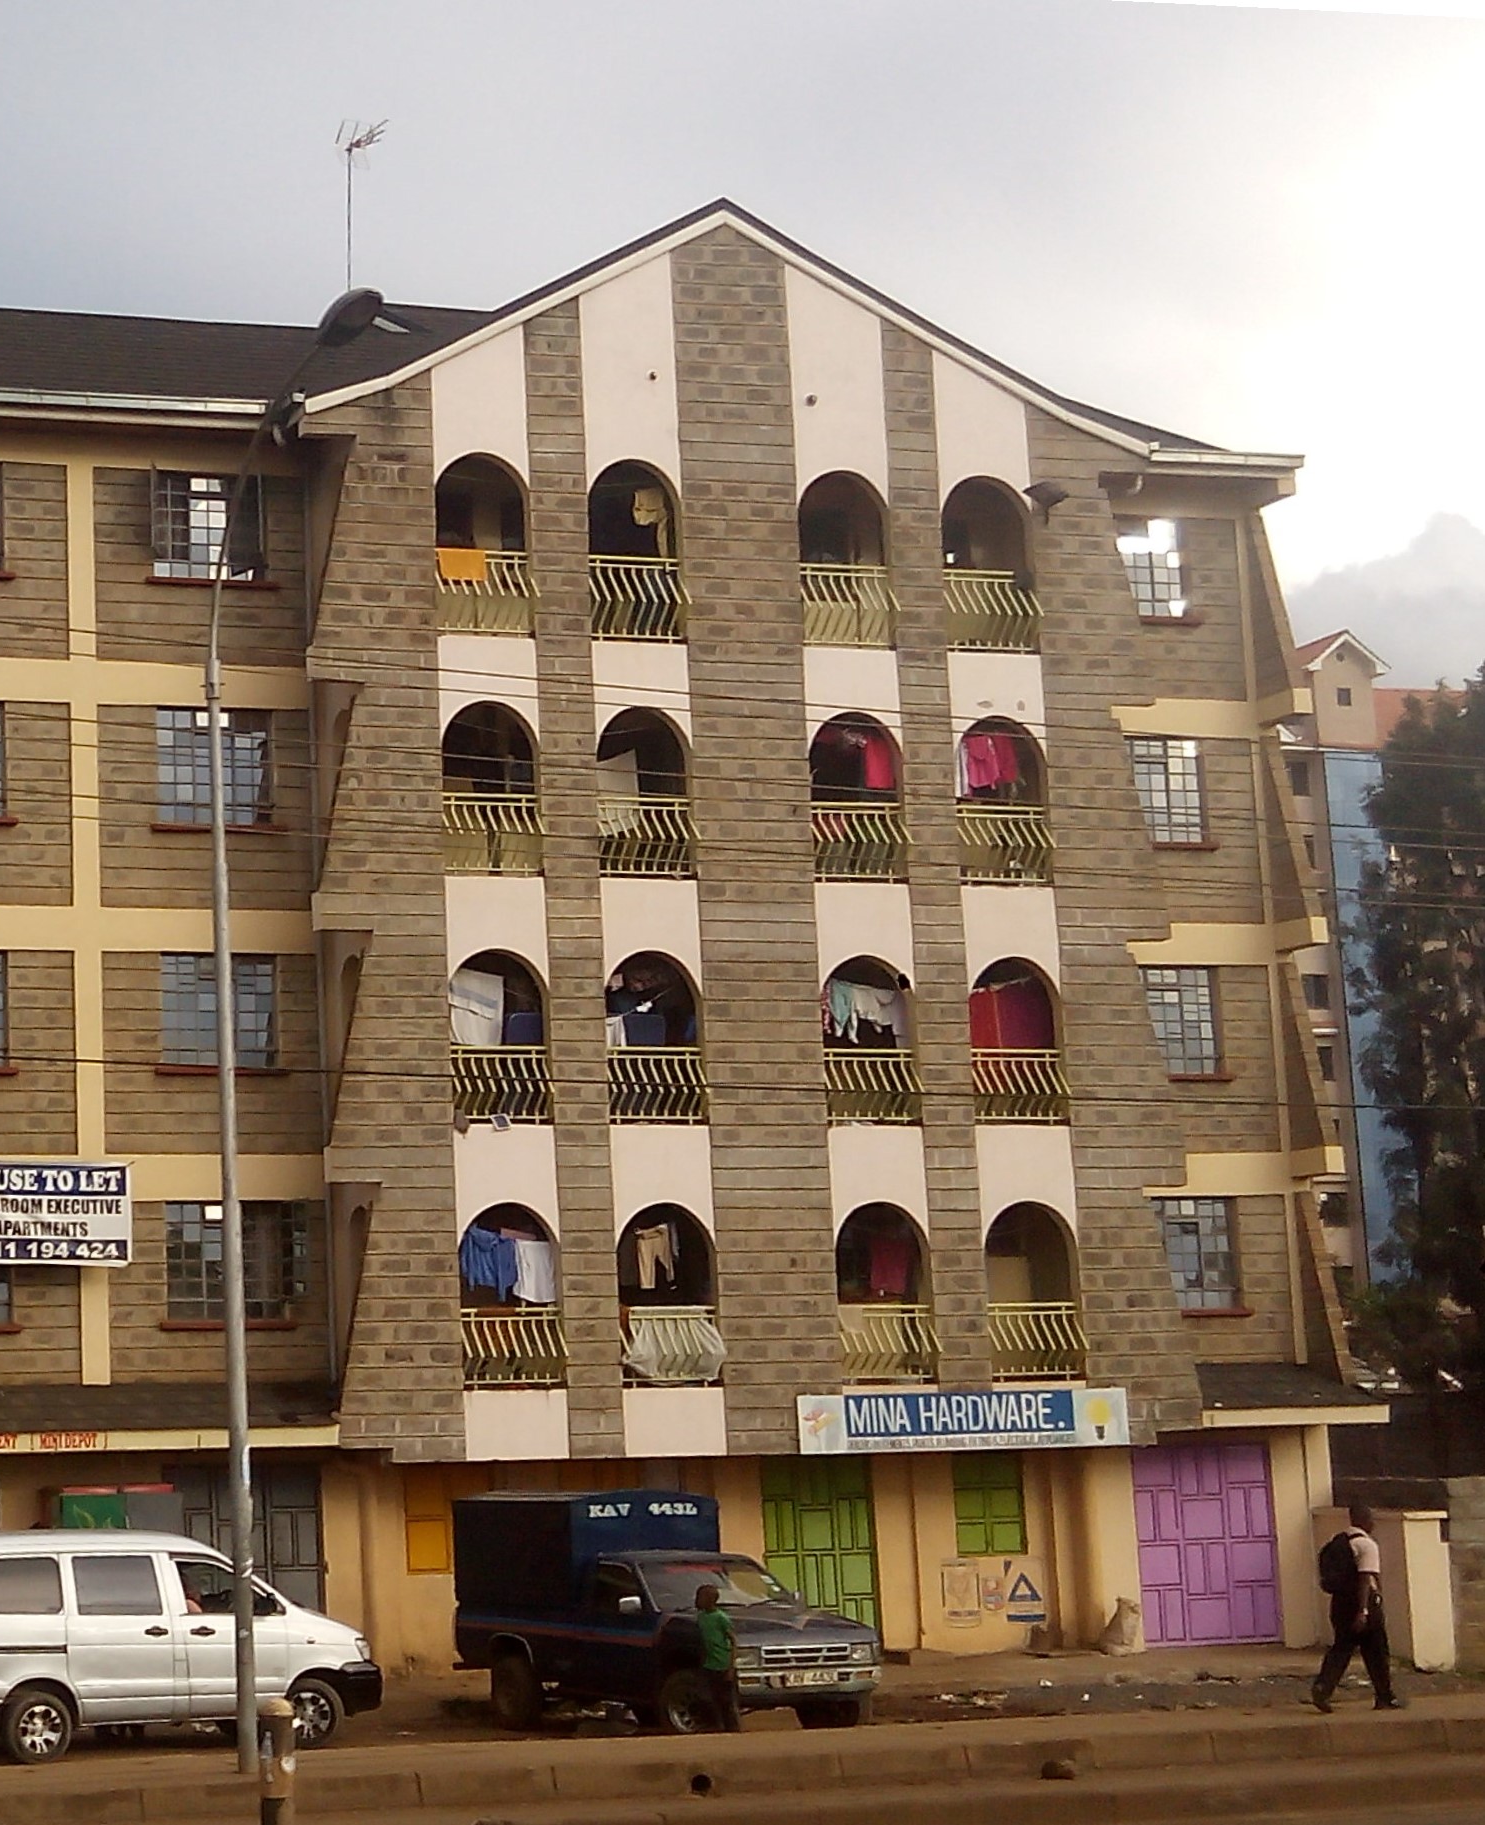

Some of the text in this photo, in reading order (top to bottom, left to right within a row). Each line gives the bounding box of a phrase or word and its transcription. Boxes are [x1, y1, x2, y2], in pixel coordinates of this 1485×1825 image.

[42, 1170, 74, 1191] TO
[78, 1170, 121, 1192] LET
[47, 1199, 122, 1215] EXECUTIVE
[26, 1241, 70, 1258] 194
[75, 1242, 119, 1259] 424
[848, 1393, 1066, 1434] MINA HARDWARE.
[64, 1432, 98, 1448] DEPOT
[588, 1502, 698, 1518] KAV 443L
